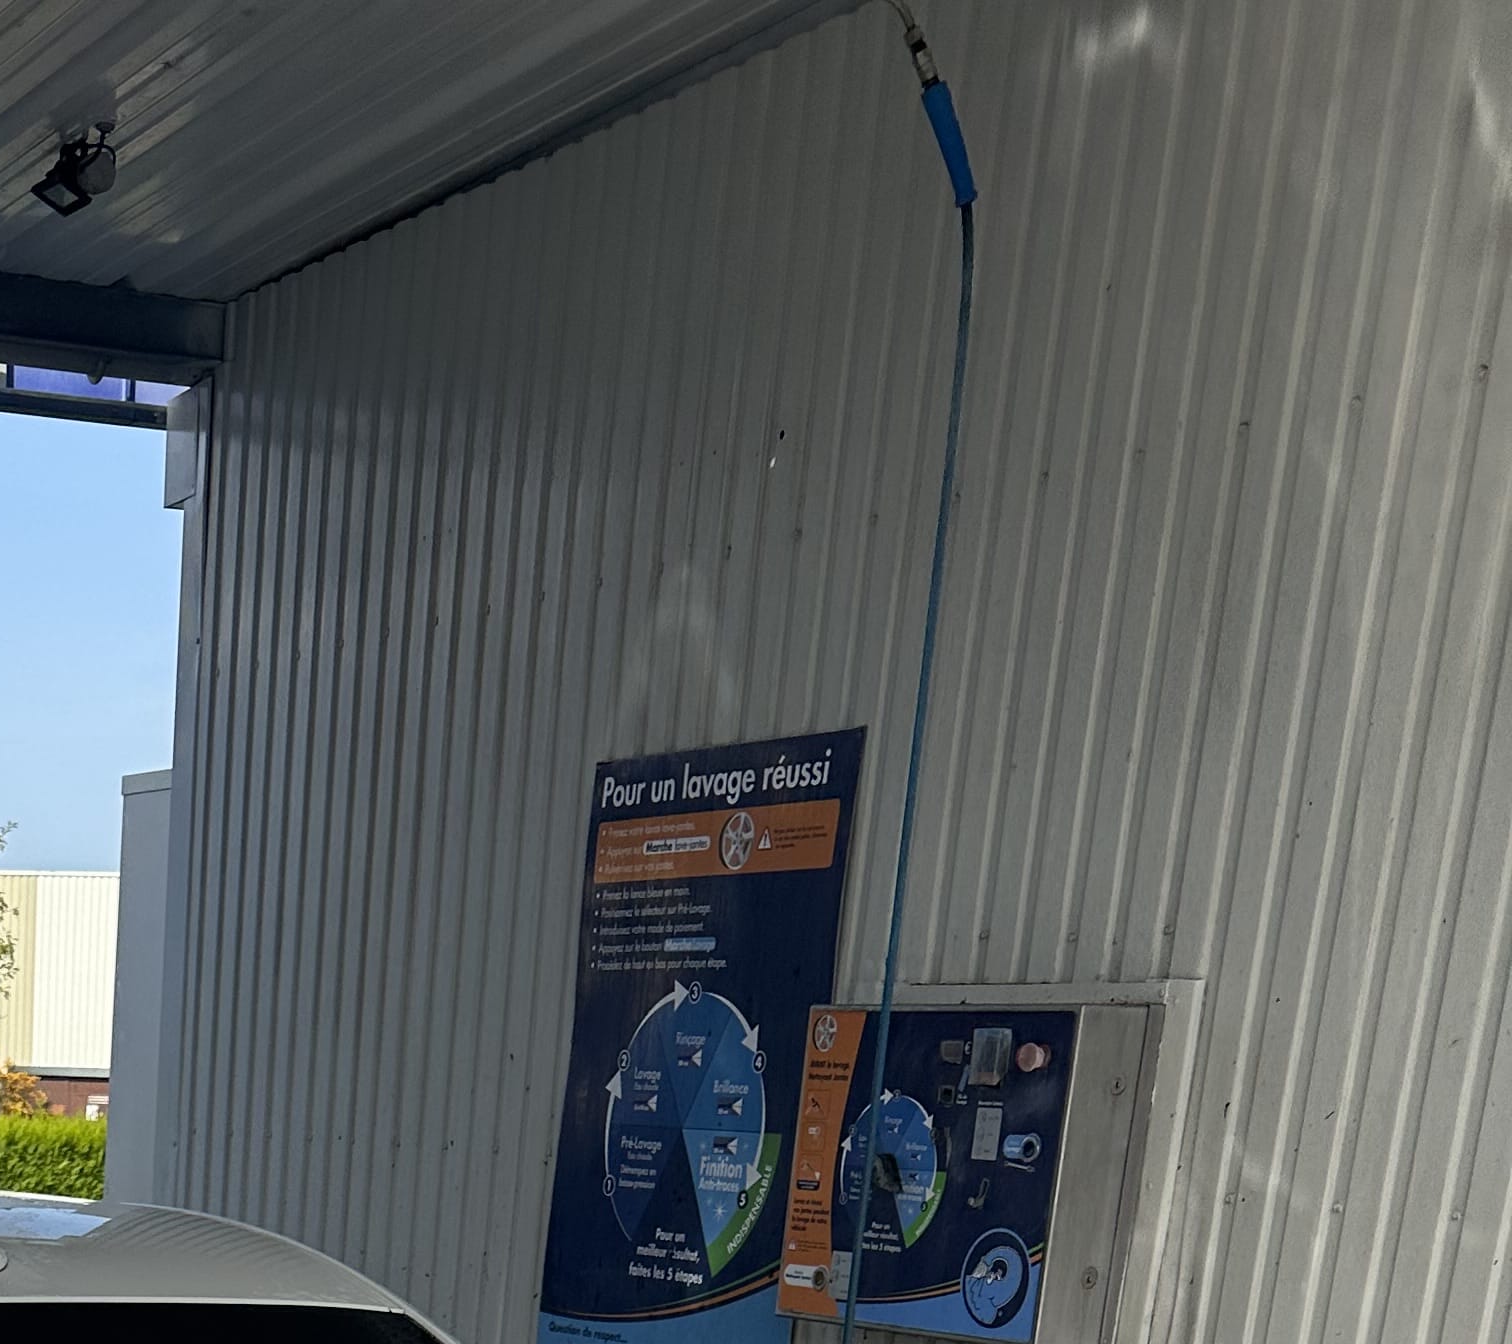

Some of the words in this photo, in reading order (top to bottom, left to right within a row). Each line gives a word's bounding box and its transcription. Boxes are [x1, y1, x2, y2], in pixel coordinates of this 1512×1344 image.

[601, 777, 646, 808] Pour
[651, 778, 675, 803] un
[682, 763, 755, 805] lavage
[762, 748, 833, 791] réussi
[646, 841, 673, 852] Marche
[675, 1031, 706, 1049] Rinçage
[634, 1066, 661, 1084] Lavage
[713, 1079, 750, 1095] Brillance
[620, 1135, 662, 1154] Pré-Lavage
[699, 1155, 743, 1179] Finition
[726, 1164, 774, 1255] INDISPENSABLE
[656, 1228, 674, 1242] Pour
[675, 1232, 686, 1242] un
[637, 1243, 667, 1257] meilleur
[629, 1261, 651, 1278] faites
[653, 1264, 665, 1279] les
[667, 1267, 673, 1281] 5
[674, 1267, 704, 1287] étapes
[548, 1320, 580, 1336] Question
[582, 1326, 592, 1338] de
